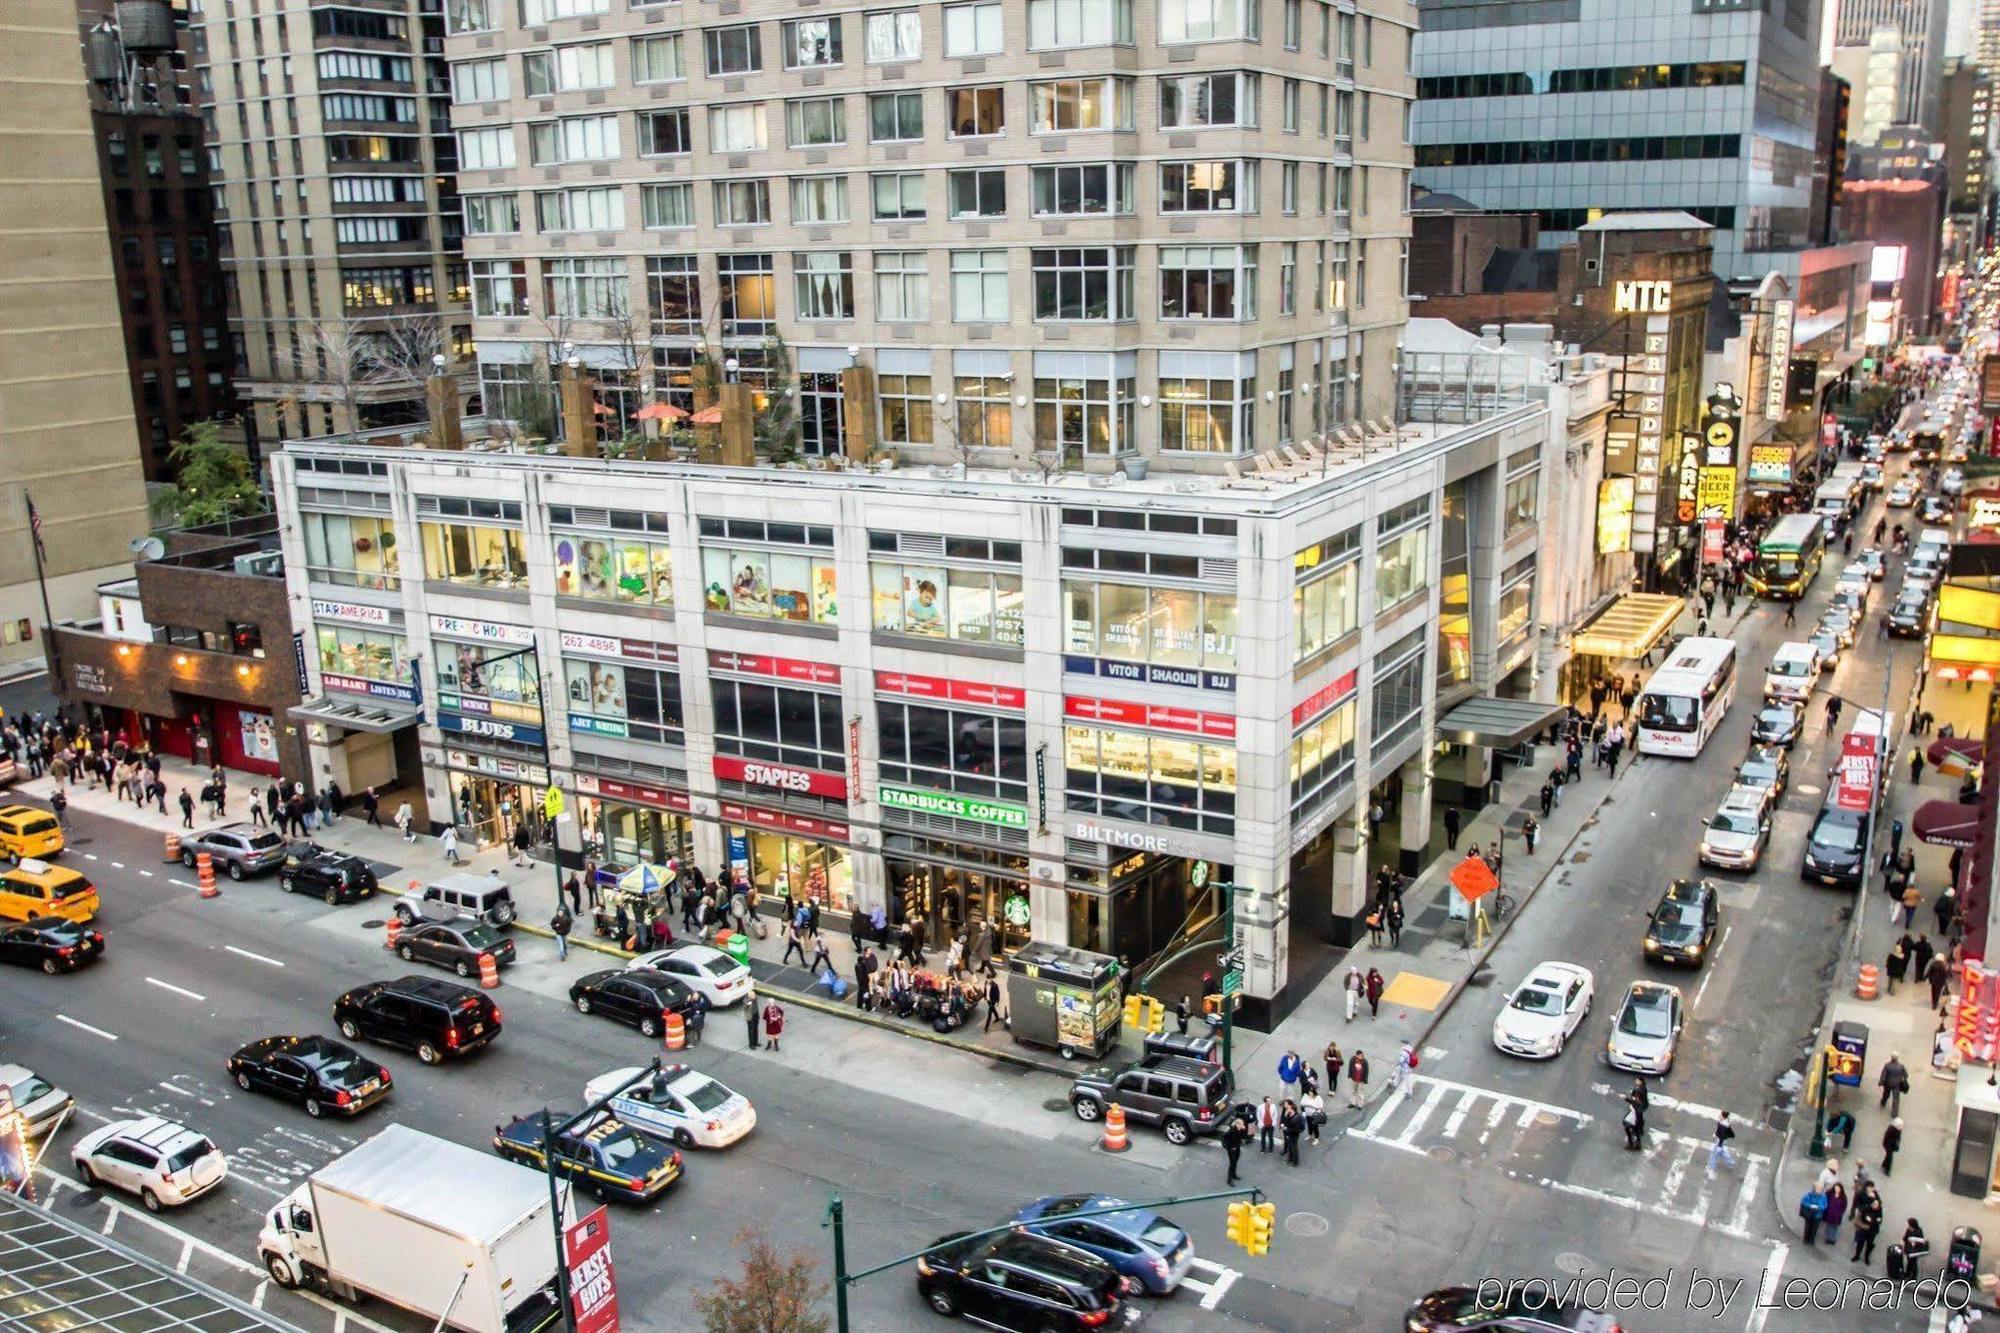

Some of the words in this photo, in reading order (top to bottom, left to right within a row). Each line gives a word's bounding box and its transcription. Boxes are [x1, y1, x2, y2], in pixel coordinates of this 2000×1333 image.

[1614, 280, 1672, 312] MTC
[1768, 303, 1789, 418] BARRYMORE
[1640, 336, 1664, 491] FRIEDMAN
[1679, 437, 1699, 500] PARK
[1701, 482, 1730, 491] BEER
[996, 631, 1024, 644] 4045
[1110, 623, 1137, 635] VITOR
[1204, 633, 1236, 655] BJJ
[1108, 663, 1140, 678] VITOR
[1151, 668, 1198, 685] SHAOLIN
[1211, 676, 1230, 689] BJJ
[324, 676, 368, 692] LIBRARY
[460, 717, 515, 739] BLUES
[571, 717, 592, 729] ART
[851, 726, 861, 796] STAPLES
[743, 763, 811, 792] STAPLES
[881, 789, 966, 815] STARBUCKS
[968, 803, 1025, 824] COFFEE
[1075, 822, 1169, 852] BILTMORE
[569, 1241, 613, 1297] JERSEY
[579, 1273, 612, 1312] BOYS
